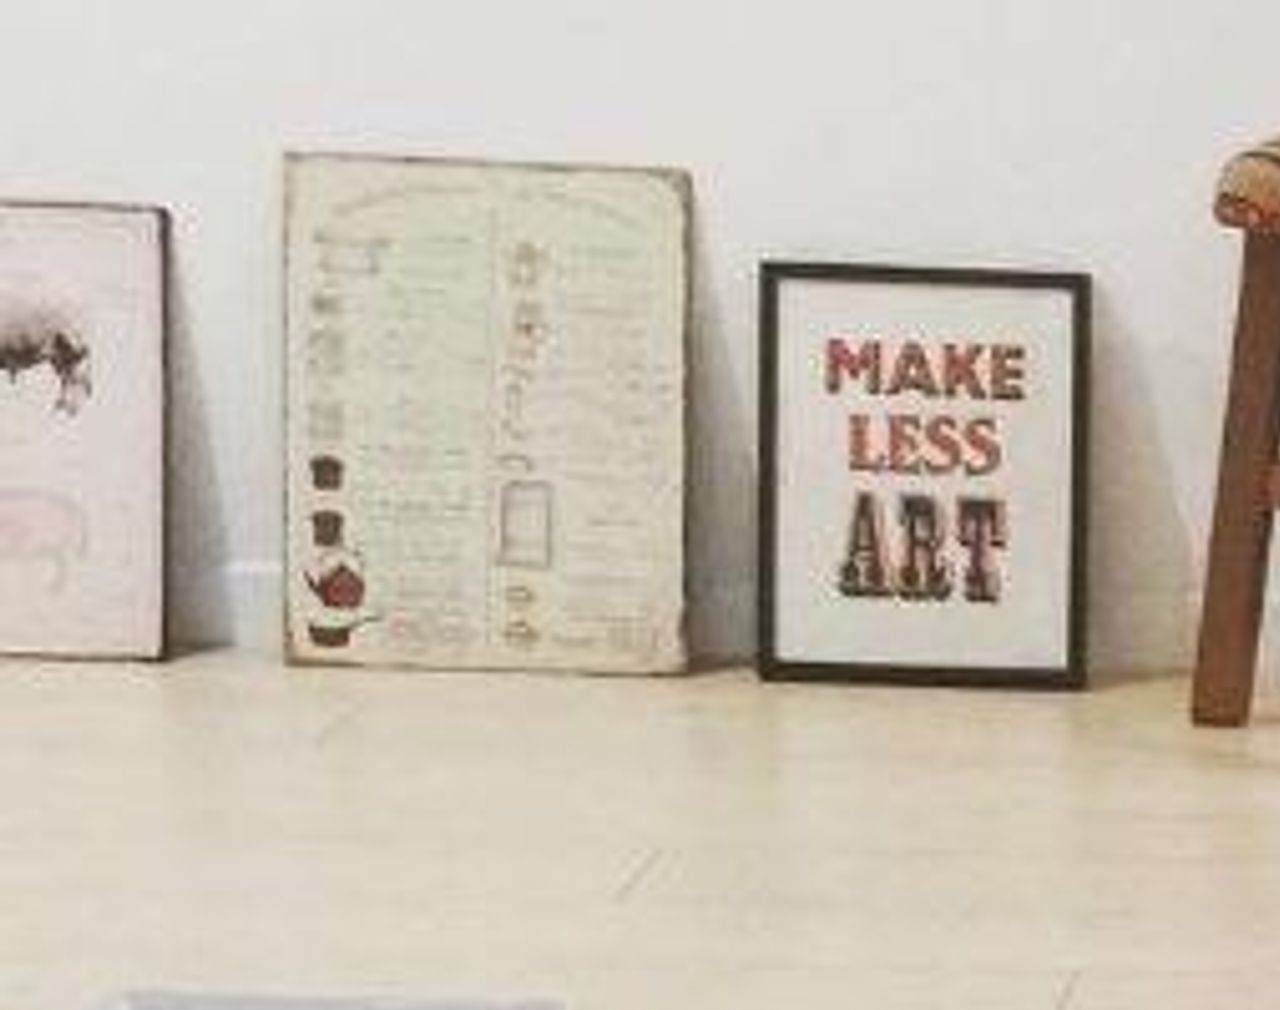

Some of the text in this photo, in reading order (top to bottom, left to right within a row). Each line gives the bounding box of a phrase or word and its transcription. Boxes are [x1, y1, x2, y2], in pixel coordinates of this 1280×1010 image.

[825, 338, 1026, 401] MAKE
[848, 413, 1001, 476] LESS
[839, 492, 1007, 603] ART
